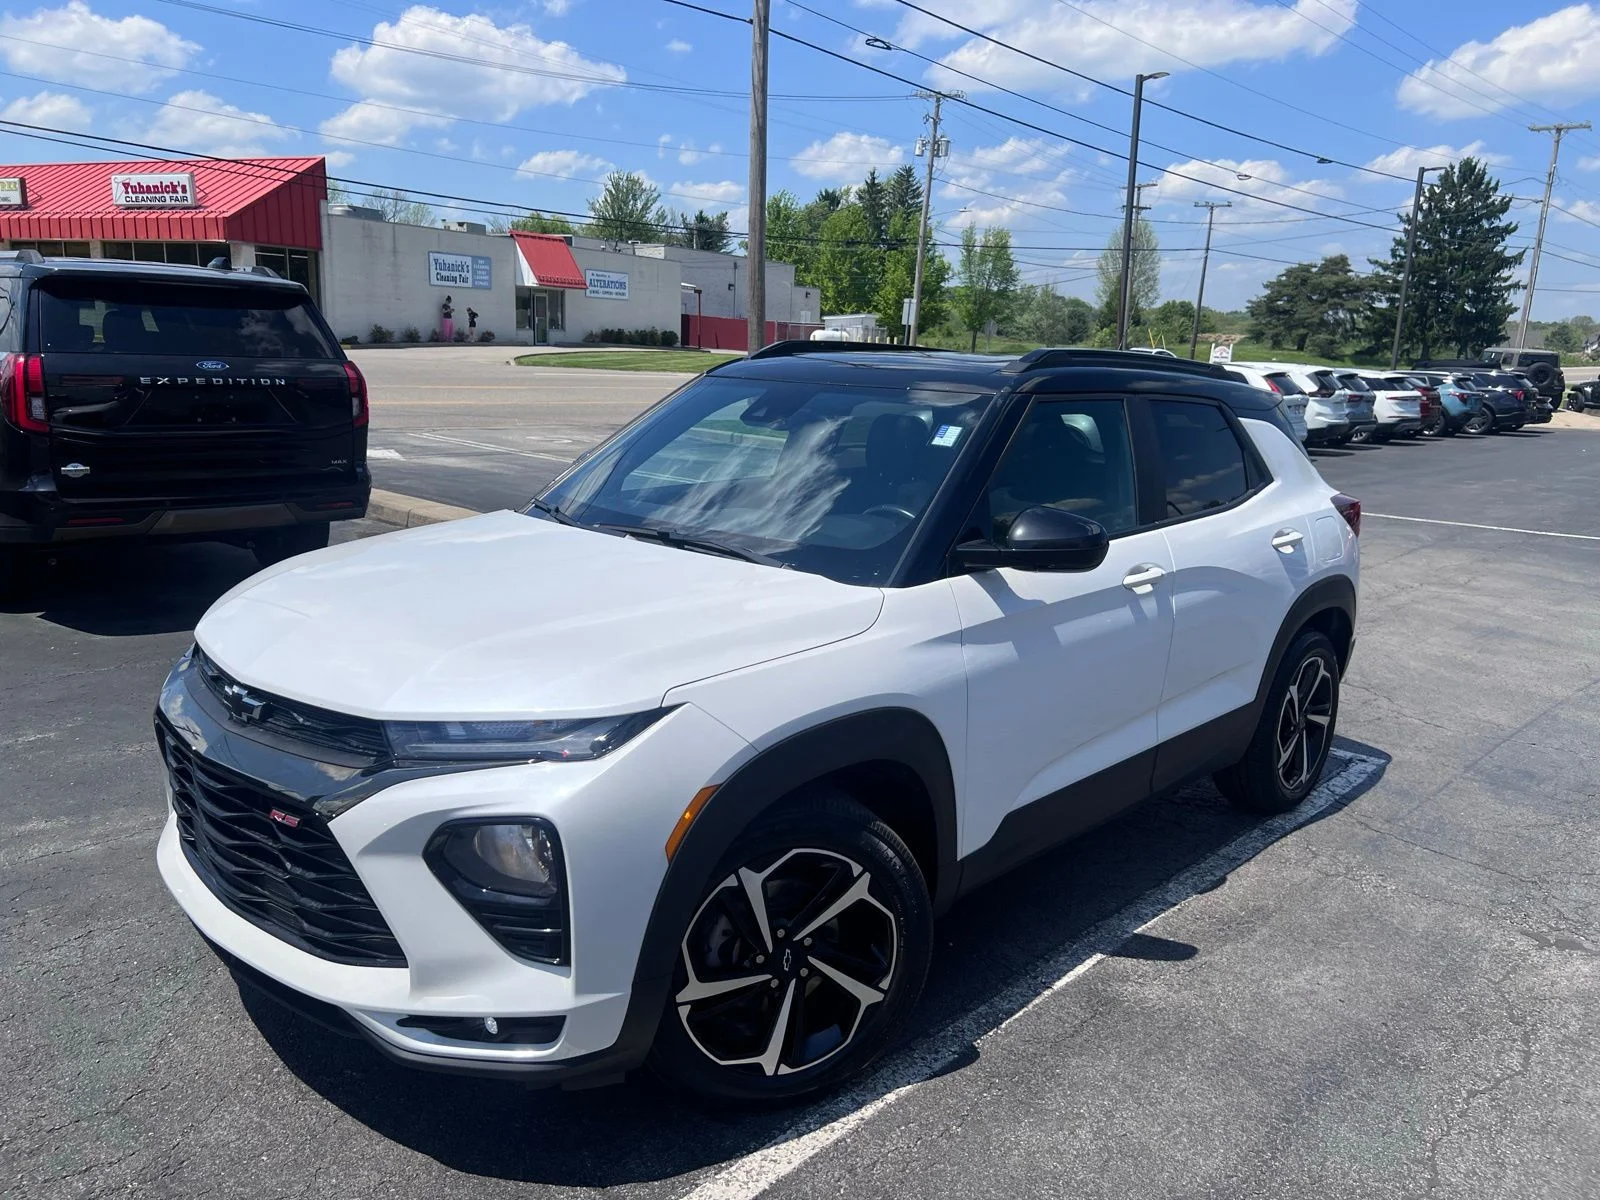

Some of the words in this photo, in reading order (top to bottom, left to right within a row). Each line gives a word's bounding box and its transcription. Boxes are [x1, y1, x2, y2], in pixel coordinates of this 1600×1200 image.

[122, 181, 187, 194] Yuhanick's
[124, 195, 166, 203] CLEANING
[169, 195, 189, 203] FAIR
[433, 258, 470, 274] Yuhanick's
[436, 271, 458, 284] Cleaning
[459, 273, 469, 284] Fair
[589, 278, 627, 290] ALTERATIONS
[139, 376, 286, 386] EXPEDITION
